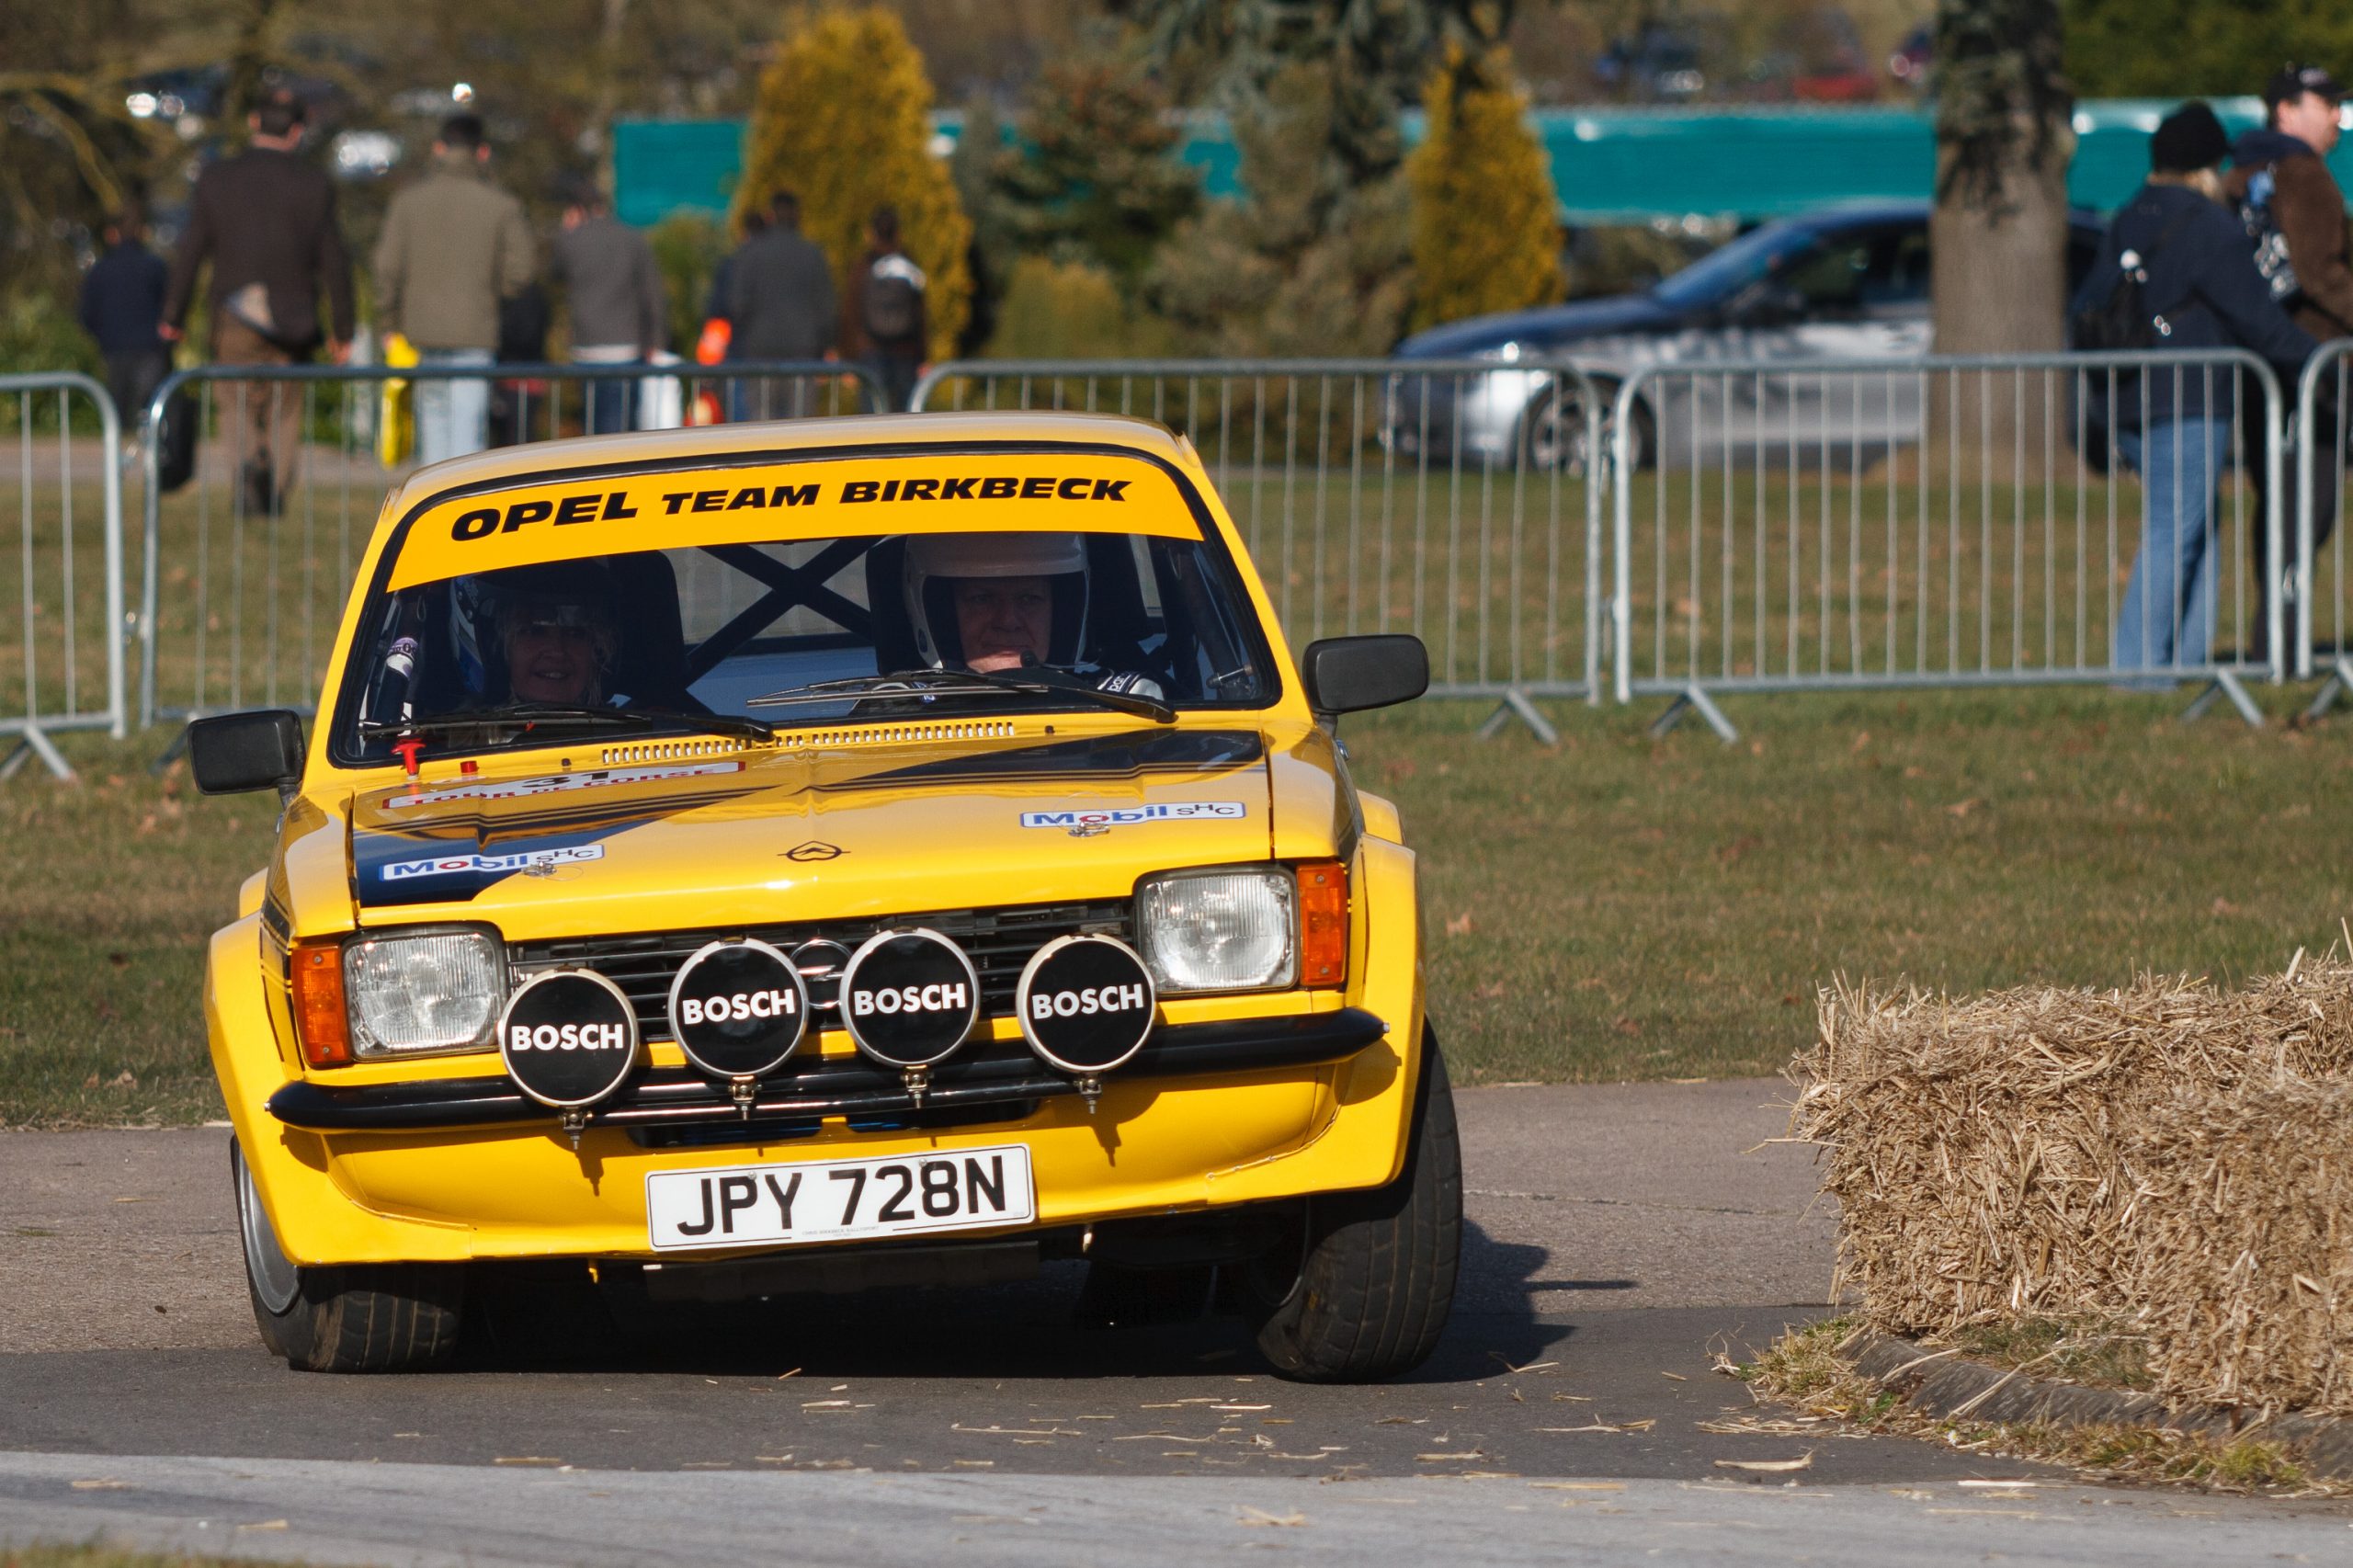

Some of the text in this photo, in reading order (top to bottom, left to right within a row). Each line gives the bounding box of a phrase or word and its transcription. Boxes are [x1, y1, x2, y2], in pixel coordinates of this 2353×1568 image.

[451, 477, 1132, 541] OPEL TEAM BIRKBECK
[1033, 803, 1235, 824] Mobil SHC
[393, 848, 595, 876] Mobil SHC
[682, 988, 796, 1025] BOSCH
[854, 983, 966, 1017] BOSCH
[1031, 983, 1144, 1020] BOSCH
[511, 1023, 624, 1051] BOSCH
[676, 1154, 1006, 1236] JPY 728N
